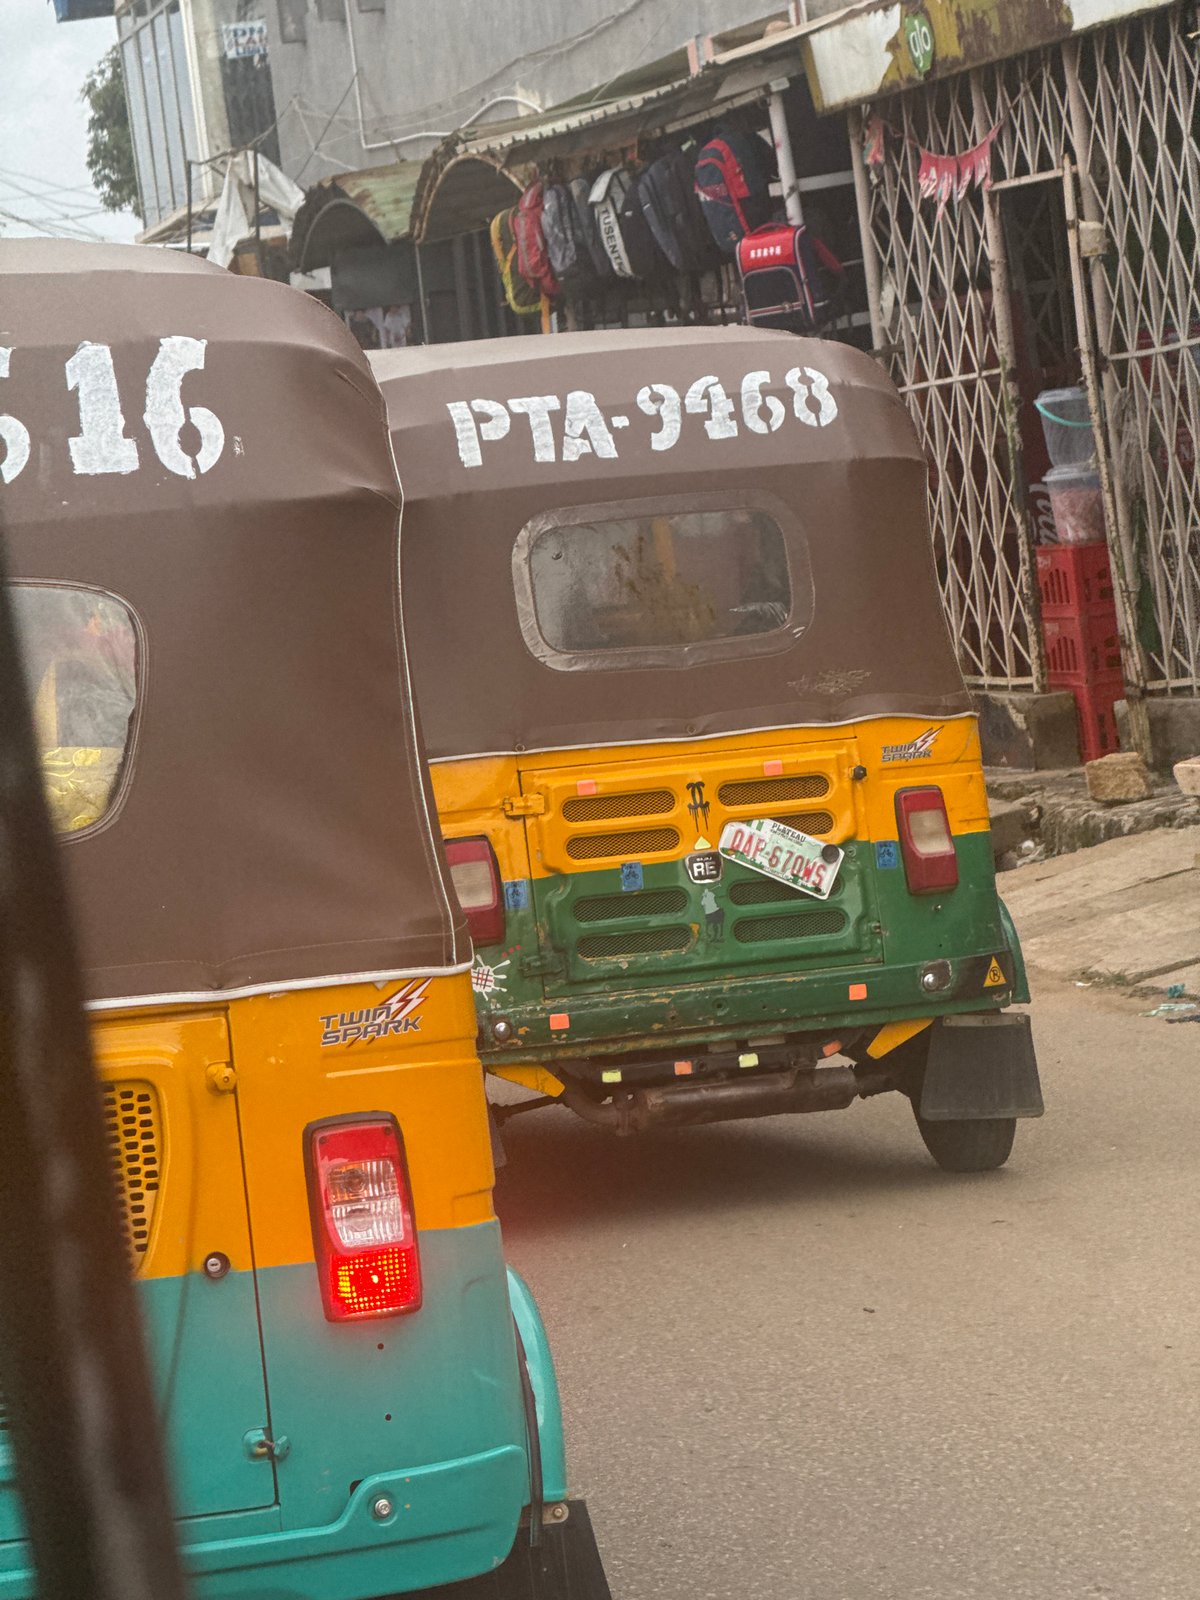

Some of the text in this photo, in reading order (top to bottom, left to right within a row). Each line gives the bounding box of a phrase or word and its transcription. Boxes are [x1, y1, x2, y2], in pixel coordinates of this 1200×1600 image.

[910, 19, 931, 68] glo
[446, 366, 839, 468] PTA-9468
[881, 741, 919, 754] TWIN
[881, 749, 932, 763] SPARK
[771, 822, 807, 844] PLATEAU
[692, 861, 717, 877] RE
[319, 1005, 393, 1031] TWIN
[320, 1016, 423, 1047] SPARK
